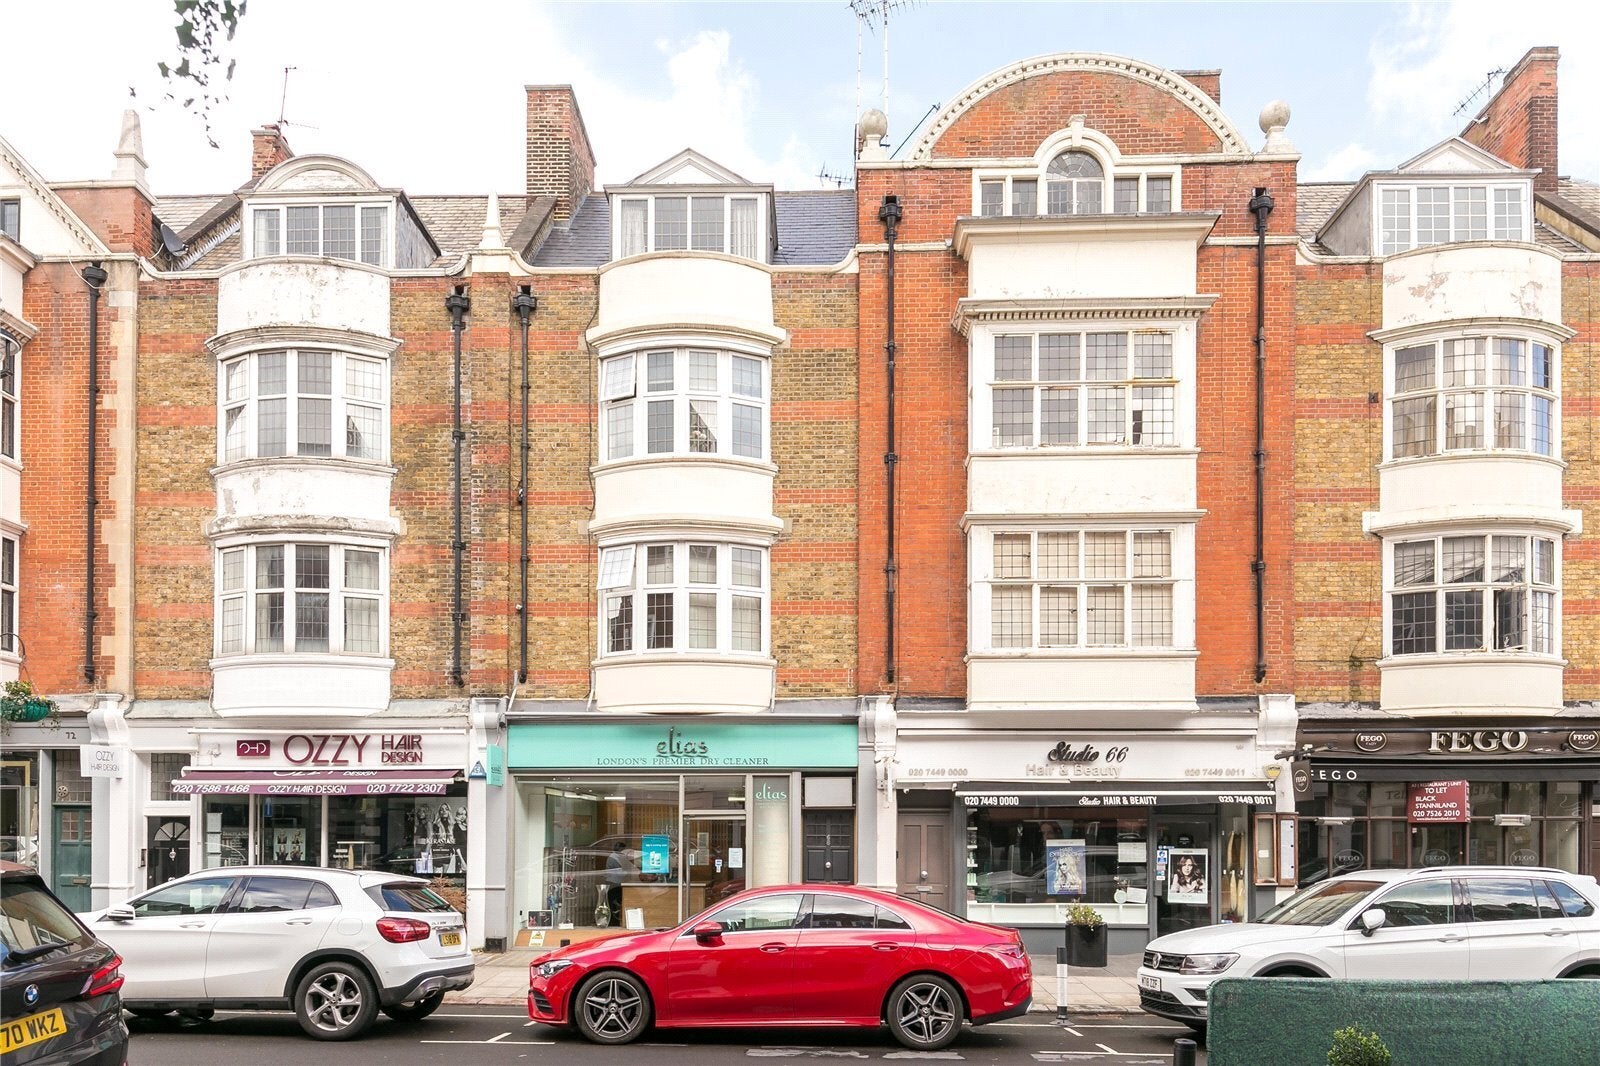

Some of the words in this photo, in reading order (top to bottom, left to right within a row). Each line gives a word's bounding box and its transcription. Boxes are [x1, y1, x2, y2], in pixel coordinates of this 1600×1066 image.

[65, 731, 77, 740] 72
[656, 726, 709, 754] elias
[381, 734, 422, 750] HAIR
[1428, 731, 1529, 753] FEGO
[283, 734, 371, 764] OZZY
[1047, 741, 1100, 762] Studio
[1105, 746, 1129, 763] 66
[95, 750, 115, 762] OZZY
[381, 751, 423, 763] DESIGN
[597, 757, 648, 766] LONDON'S
[652, 757, 696, 766] PREMIER
[700, 757, 719, 766] DRY
[723, 757, 769, 766] CLEANER
[90, 763, 102, 771] HAIR
[102, 763, 120, 772] DESIGN
[908, 768, 923, 776] 020
[926, 768, 946, 776] 7449
[1025, 762, 1055, 777] Hair
[1059, 763, 1069, 777] &
[1073, 763, 1122, 779] Beauty
[172, 784, 193, 793] 020
[196, 784, 221, 793] 7586
[224, 784, 250, 793] 1466
[267, 785, 291, 793] OZZY
[292, 785, 314, 793] HAIR
[315, 785, 347, 794] DESIGN
[366, 784, 386, 793] 020
[388, 784, 414, 793] 7722
[416, 783, 443, 793] 2307
[755, 782, 787, 800] elias
[964, 796, 979, 806] 020
[980, 796, 998, 806] 7449
[999, 796, 1019, 806] 0000
[1103, 796, 1121, 805] HAIR
[1122, 796, 1128, 805] &
[1130, 796, 1157, 805] BEAUTY
[1218, 795, 1234, 803] 020
[1234, 796, 1254, 804] 7449
[1254, 796, 1273, 805] 0011
[0, 1022, 24, 1048] 70
[26, 1012, 60, 1040] WKZ
